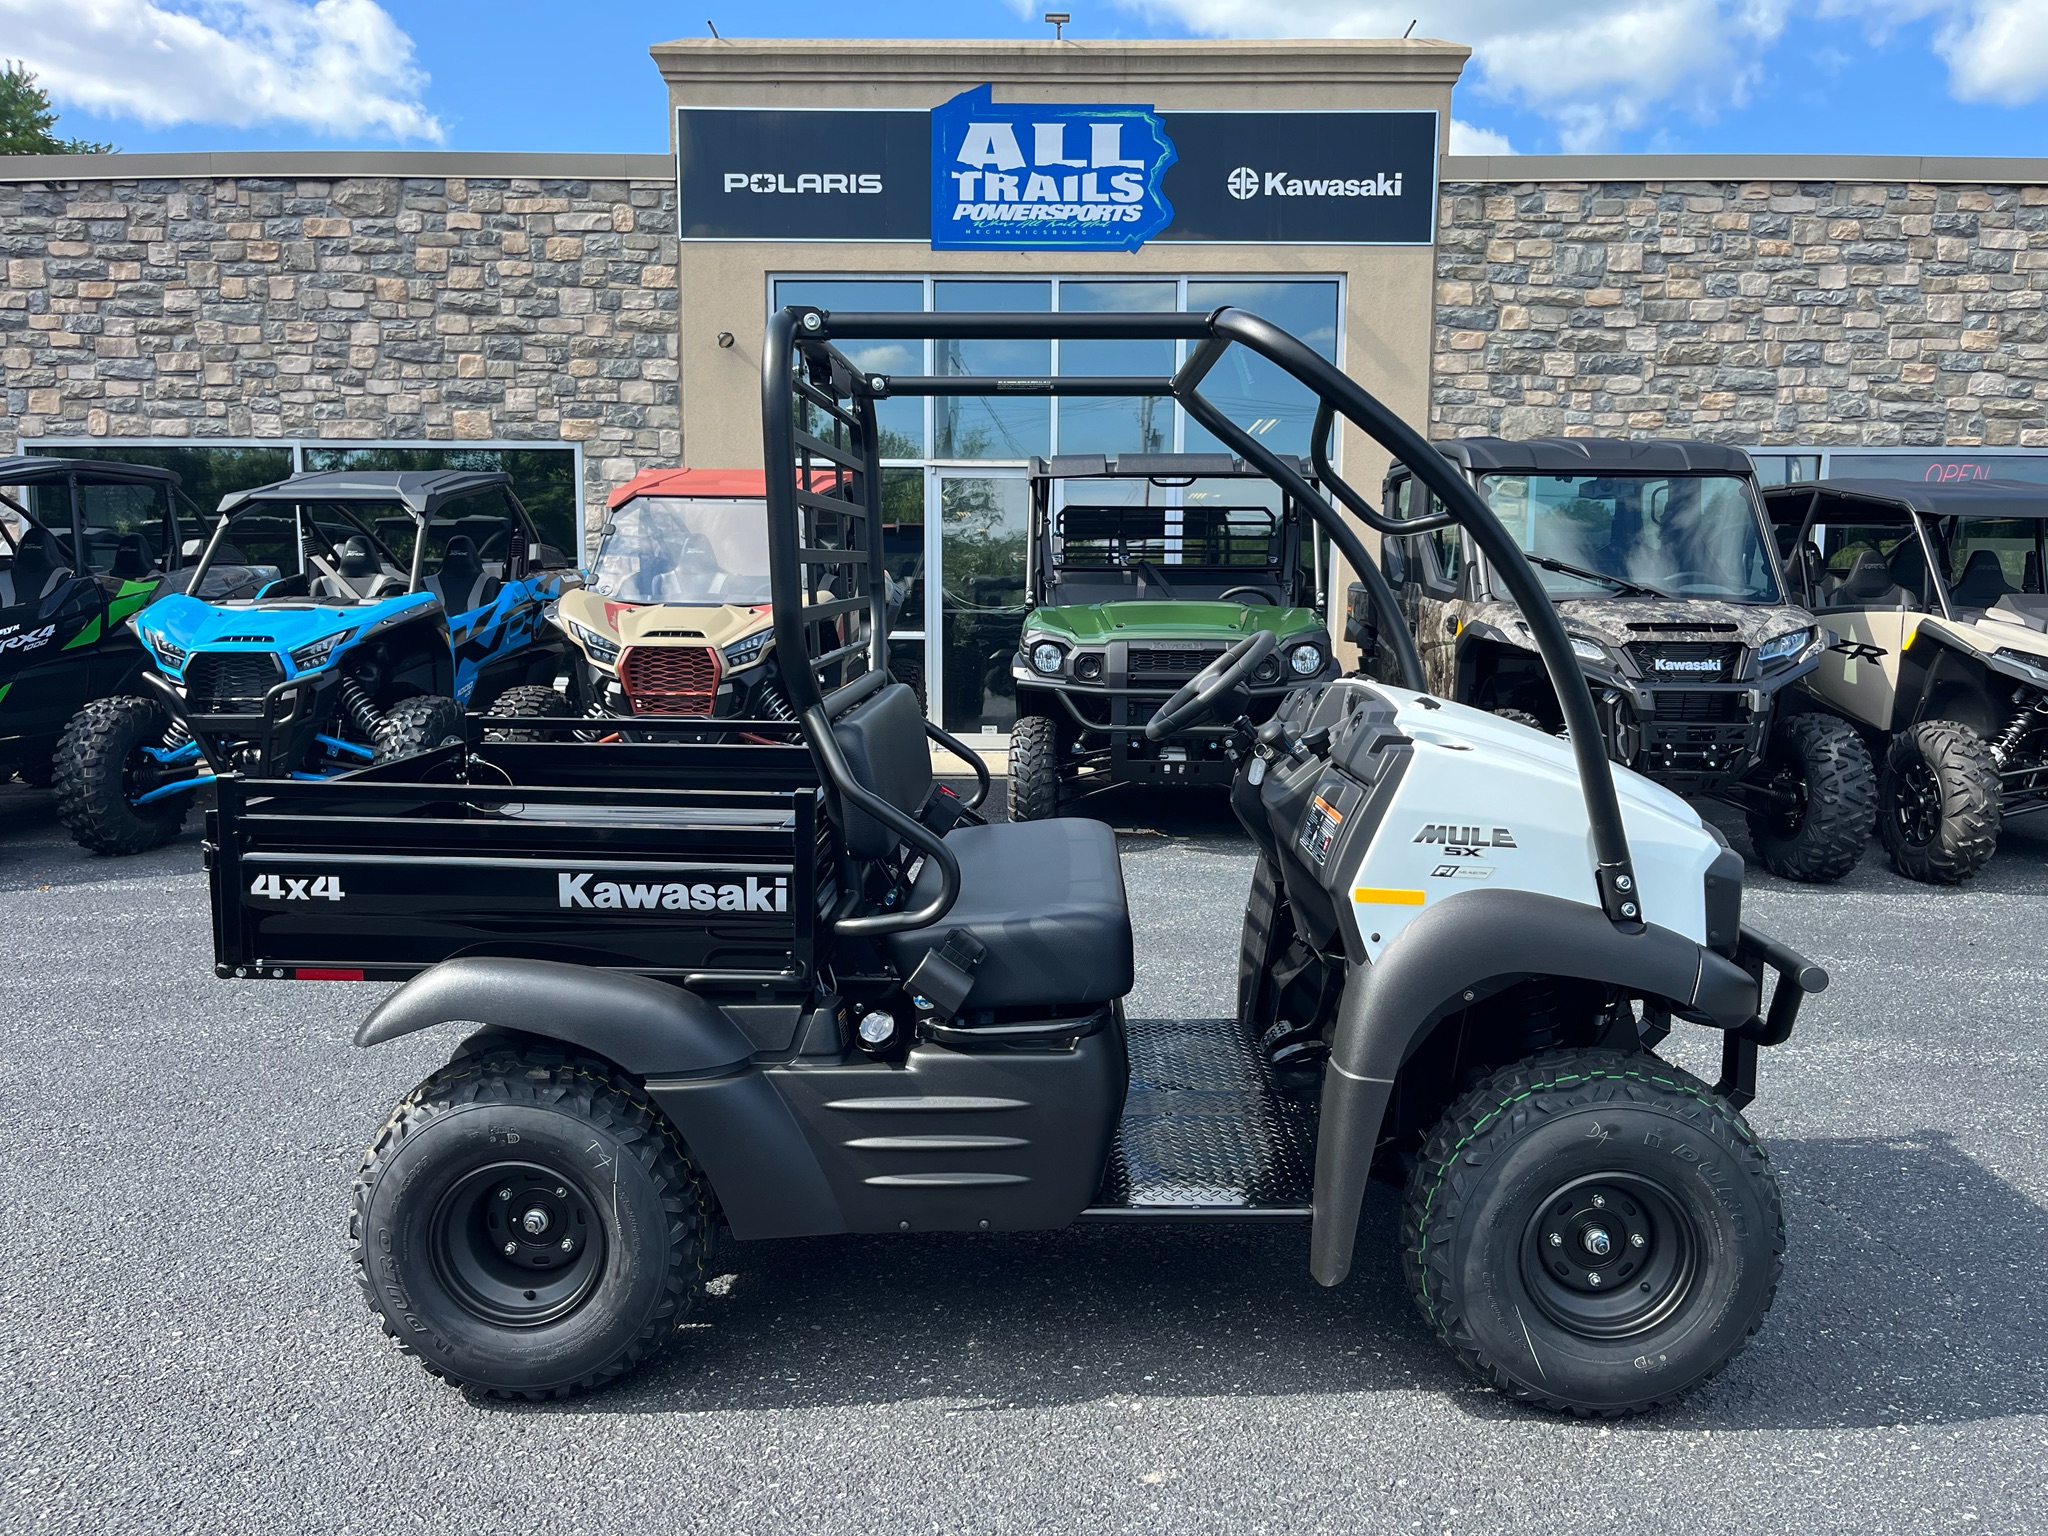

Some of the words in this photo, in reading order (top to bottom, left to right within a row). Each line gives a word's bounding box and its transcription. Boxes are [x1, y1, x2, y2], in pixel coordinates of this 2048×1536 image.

[956, 122, 1145, 171] ALL
[723, 173, 883, 194] POLARIS
[951, 171, 1145, 203] TRAILS
[1264, 172, 1403, 197] Kawasaki
[952, 203, 1143, 222] POWERSPORTS
[1925, 463, 1991, 482] OPEN
[0, 624, 56, 654] RX4
[23, 638, 49, 652] 1000
[1654, 659, 1721, 671] Kawasaki
[1412, 824, 1518, 849] MULE
[1443, 846, 1486, 858] SX
[250, 874, 346, 901] 4x4
[558, 873, 788, 912] Kawasaki
[378, 1227, 429, 1332] DURO
